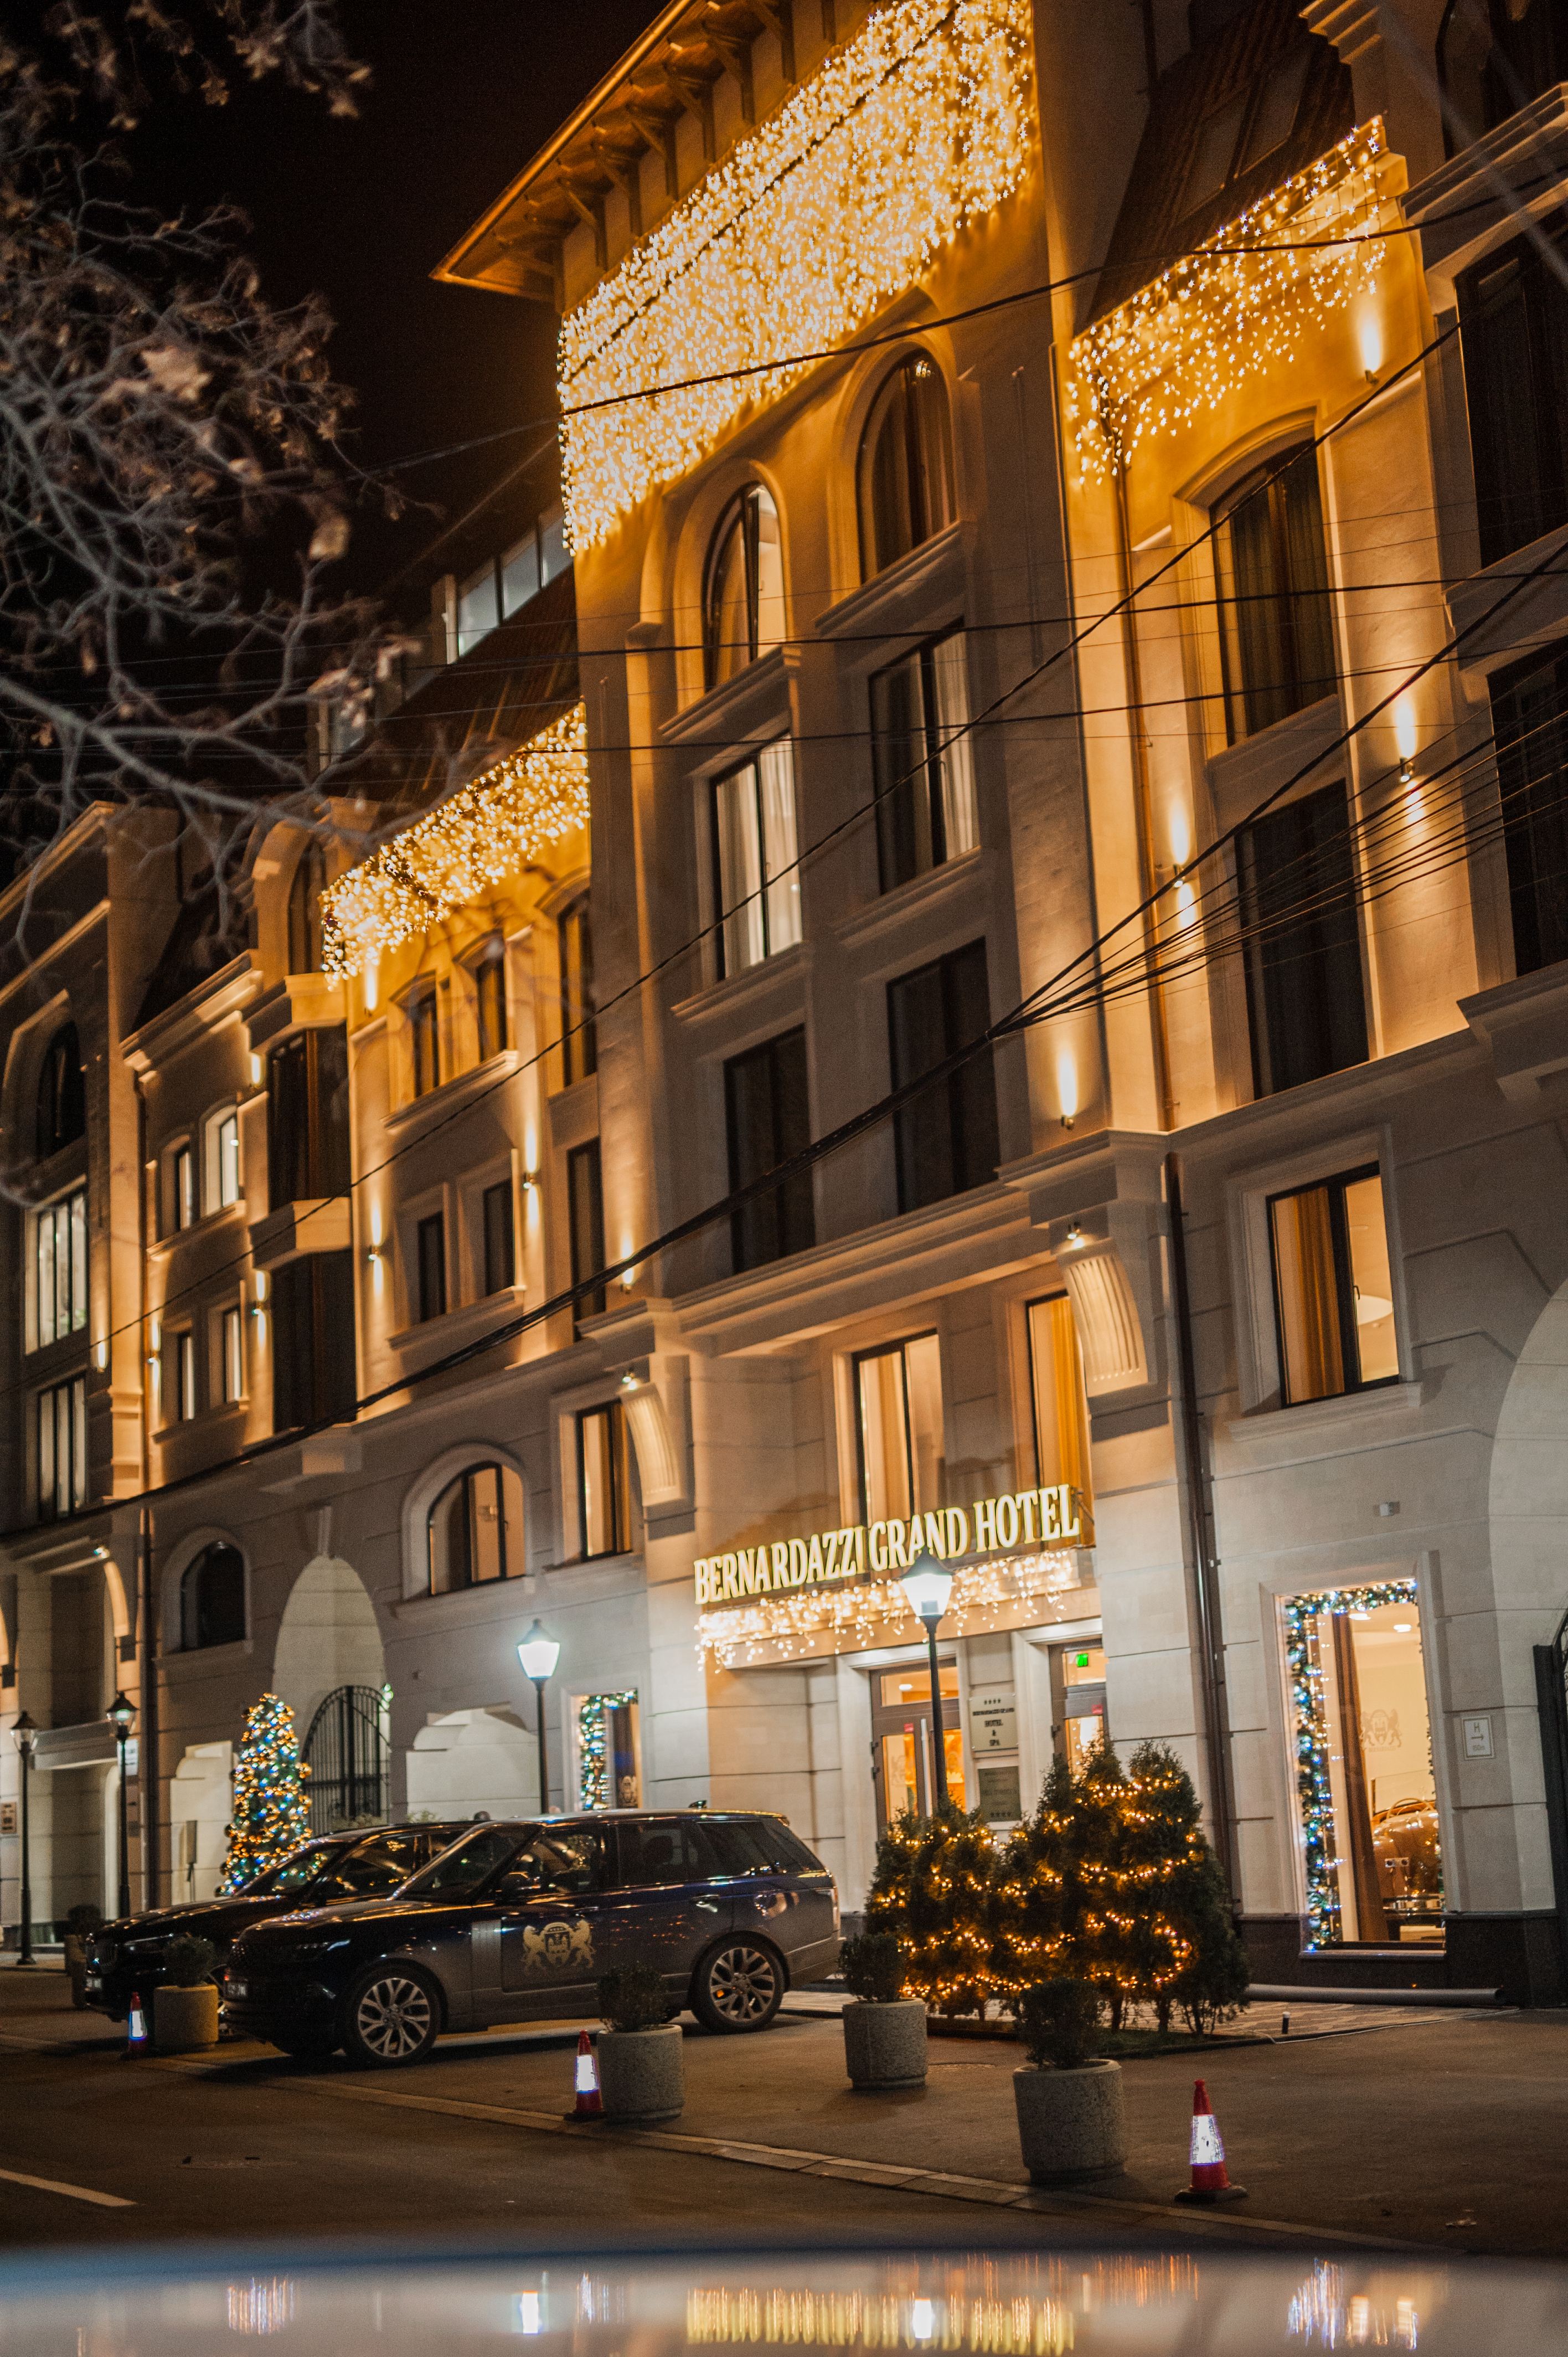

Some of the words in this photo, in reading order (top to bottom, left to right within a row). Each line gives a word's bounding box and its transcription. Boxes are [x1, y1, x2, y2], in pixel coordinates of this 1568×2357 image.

[694, 1526, 865, 1605] BERNARDAZZI
[869, 1507, 969, 1572] GRAND
[973, 1484, 1080, 1553] HOTEL
[1474, 1722, 1480, 1732] H
